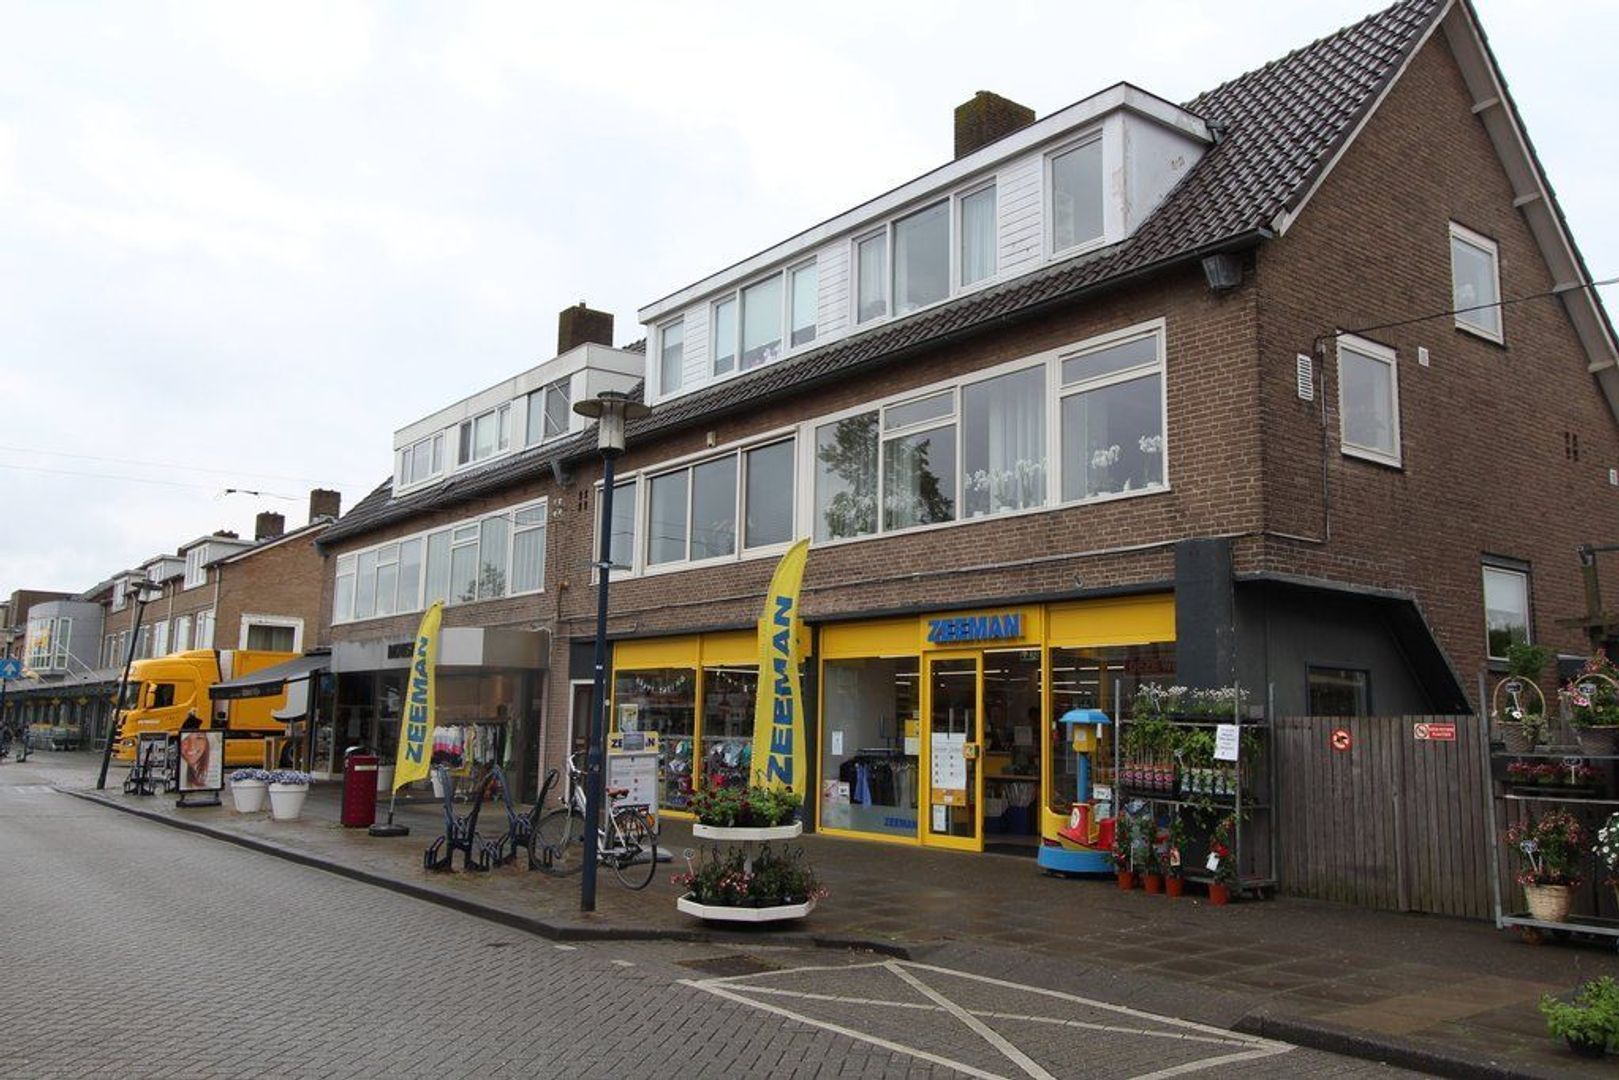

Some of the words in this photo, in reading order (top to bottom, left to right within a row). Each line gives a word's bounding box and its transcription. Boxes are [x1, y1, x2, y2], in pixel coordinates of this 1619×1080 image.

[927, 613, 1022, 644] ZEEMAN
[405, 636, 429, 764] ZEEMAN
[766, 595, 794, 785] ZEEMAN
[883, 816, 917, 829] ZEEMAN
